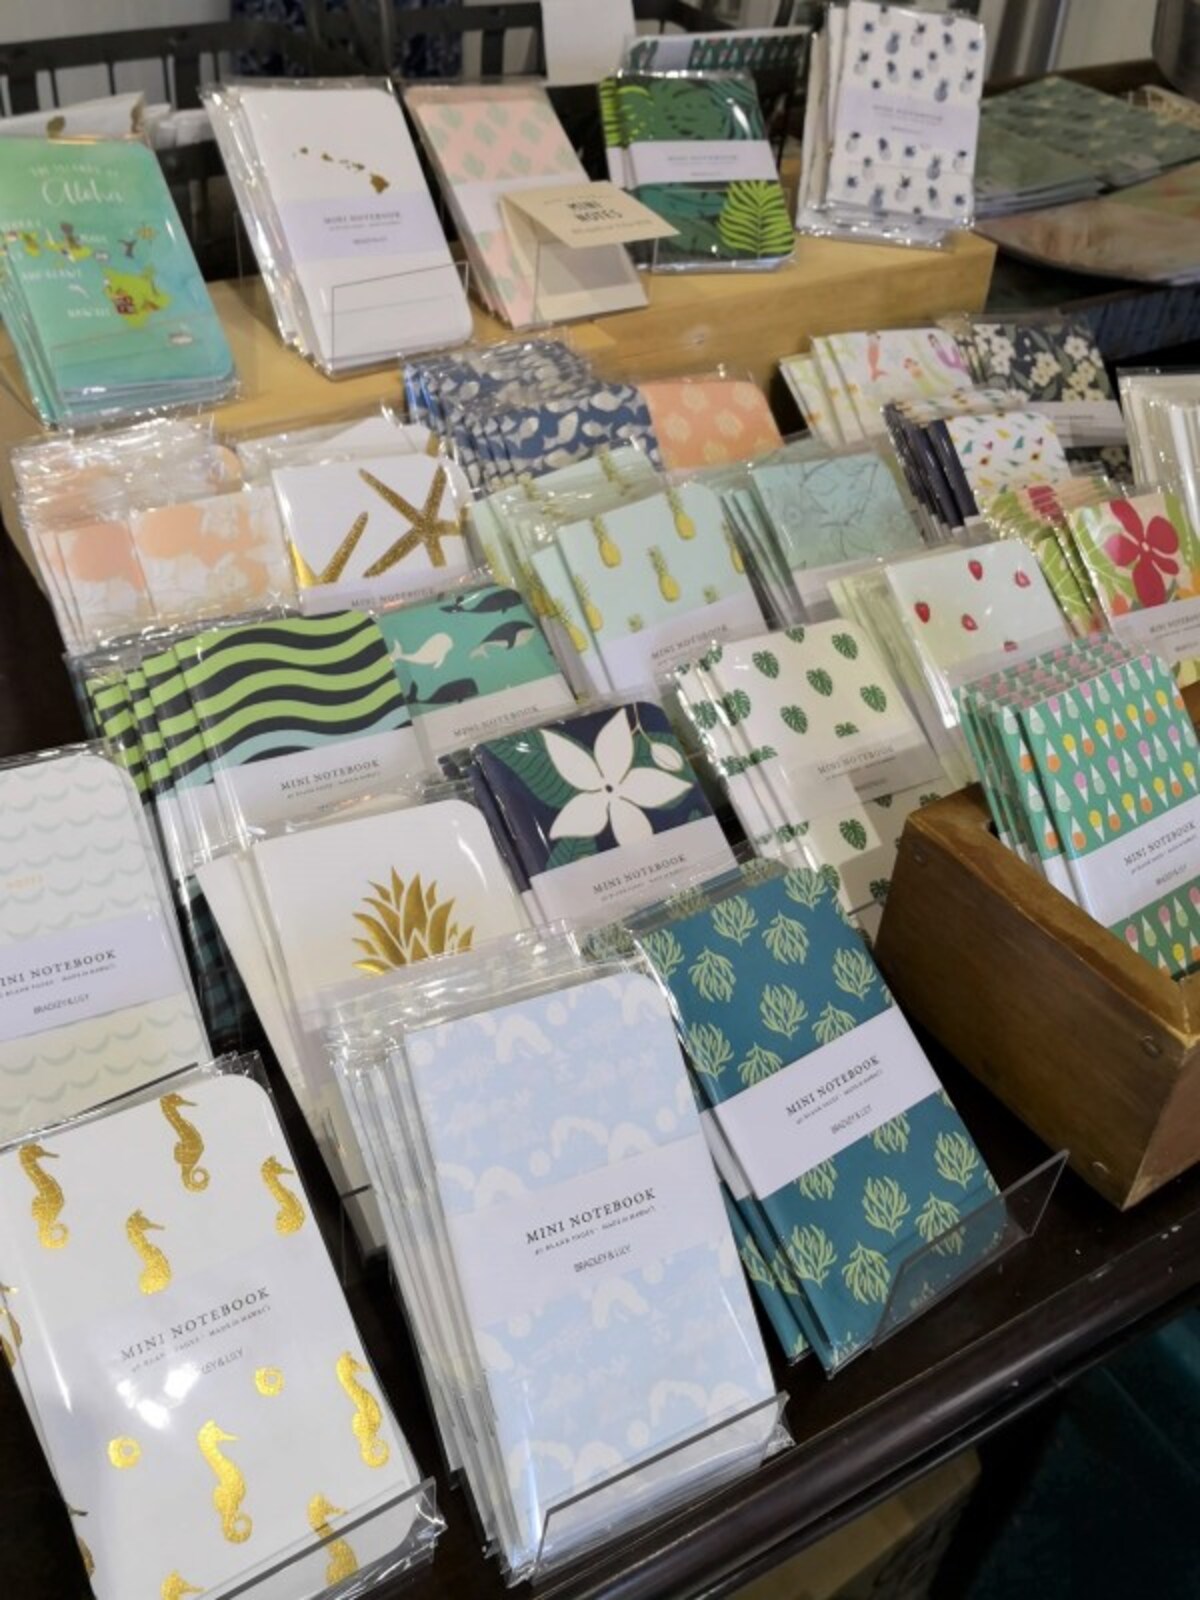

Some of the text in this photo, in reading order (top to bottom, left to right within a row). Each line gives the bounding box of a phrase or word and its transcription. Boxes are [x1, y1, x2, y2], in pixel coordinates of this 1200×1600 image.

[41, 177, 125, 206] Aloha
[454, 704, 539, 736] MINI NOTEBOOK
[281, 775, 311, 790] MINI
[313, 760, 379, 781] NOTEBOOK
[1123, 846, 1147, 867] MINI
[1147, 821, 1196, 852] NOTEBOOK
[593, 876, 622, 894] MINI
[623, 854, 685, 882] NOTEBOOK
[0, 949, 117, 987] INI NOTEBOOK
[785, 1055, 879, 1116] MINI NOTEBOOK
[526, 1187, 656, 1244] MINI NOTEBOOK
[120, 1285, 270, 1361] MINI NOTEBOOK
